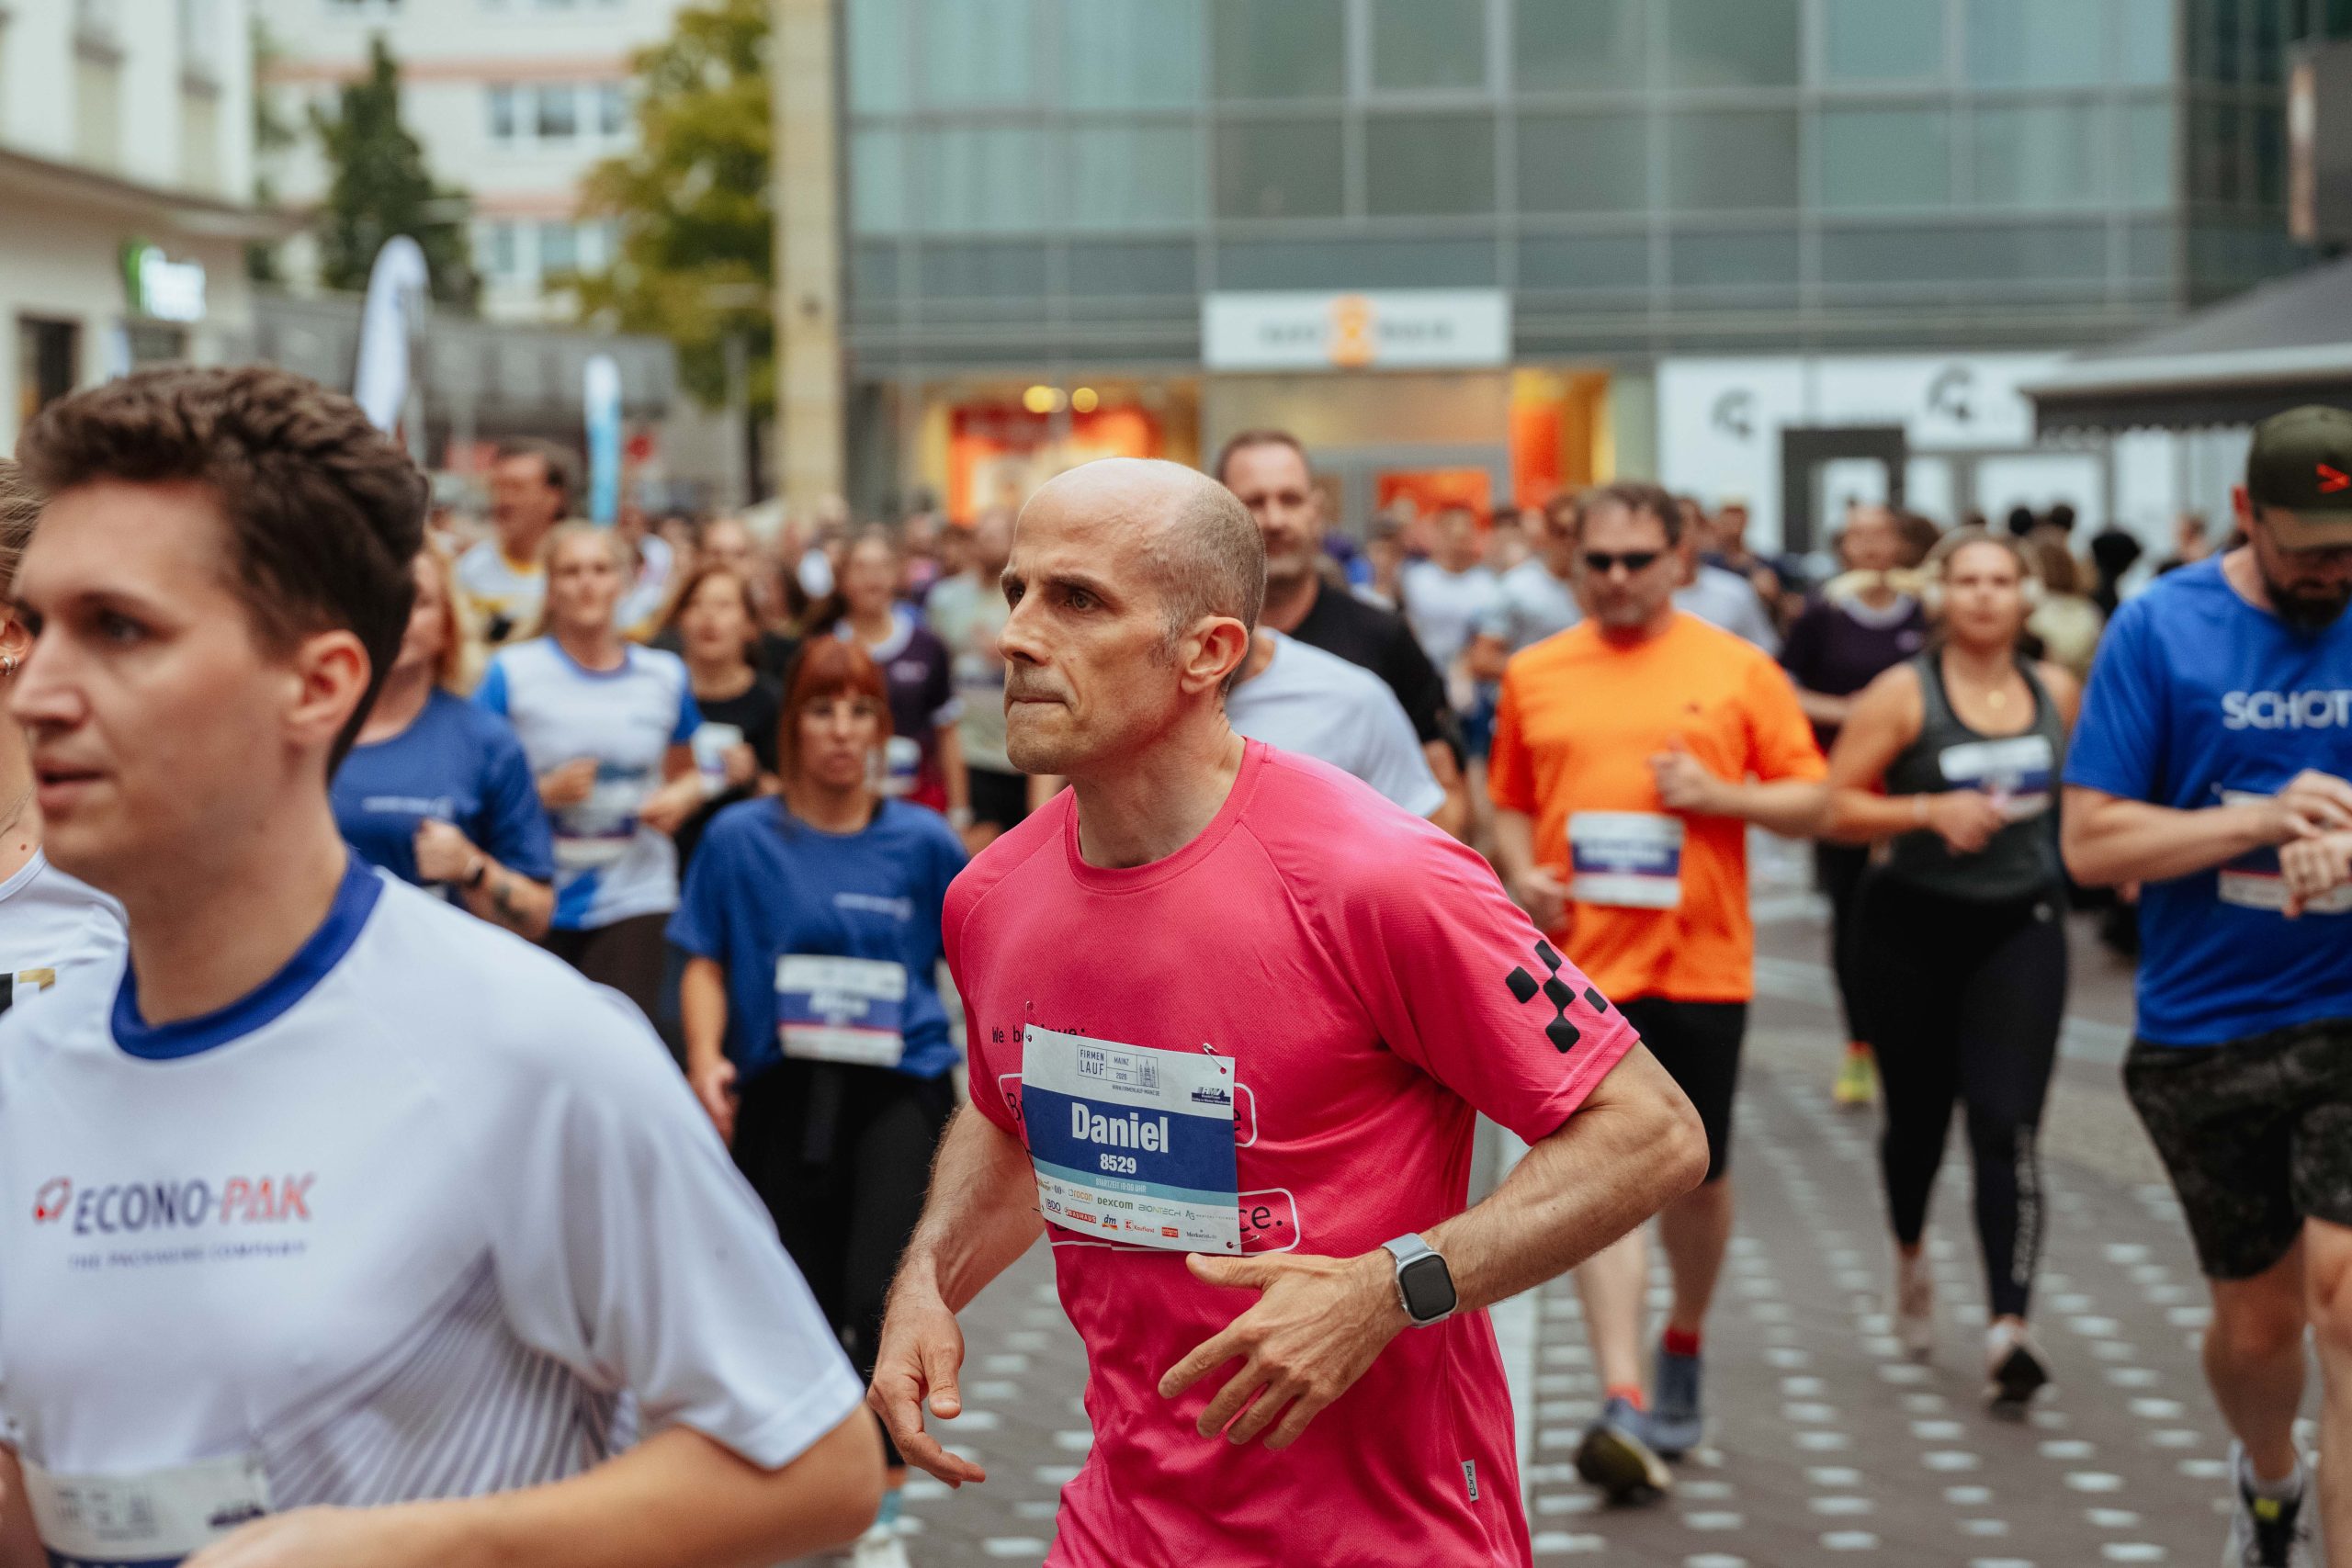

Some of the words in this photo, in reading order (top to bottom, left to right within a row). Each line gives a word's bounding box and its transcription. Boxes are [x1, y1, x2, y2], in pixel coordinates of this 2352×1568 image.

[991, 1026, 1004, 1043] We
[1080, 1049, 1104, 1061] FIRMEN
[1114, 1056, 1130, 1066] MAINZ
[1080, 1060, 1104, 1076] LAUF
[1071, 1101, 1169, 1154] Daniel
[1100, 1153, 1137, 1174] 8529
[1135, 1183, 1147, 1192] UHR
[1069, 1210, 1096, 1224] BAUHAUS
[1103, 1213, 1116, 1225] dm
